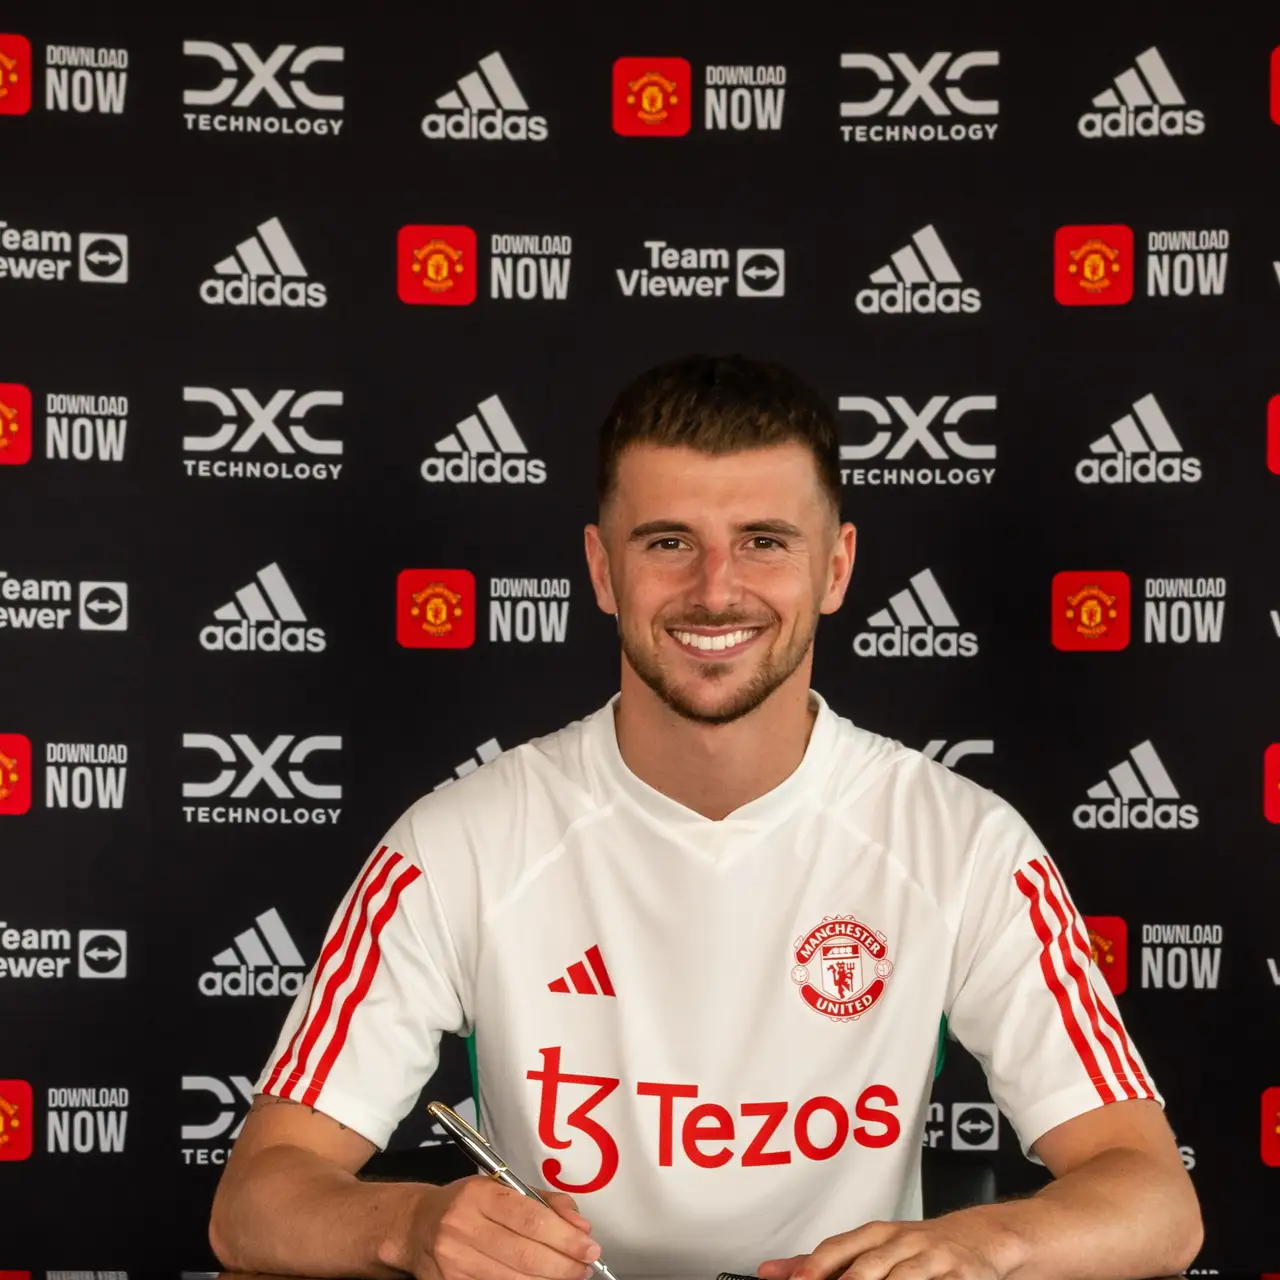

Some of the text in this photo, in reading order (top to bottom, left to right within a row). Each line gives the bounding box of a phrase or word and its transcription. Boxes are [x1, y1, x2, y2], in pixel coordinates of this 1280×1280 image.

[46, 44, 129, 69] DOWNLOAD
[45, 67, 127, 114] NOW
[183, 40, 344, 111] DXC
[705, 65, 786, 86] DOWNLOAD
[839, 50, 1000, 117] DXC
[183, 113, 343, 136] TECHNOLOGY
[421, 107, 549, 141] adidas
[705, 87, 785, 130] NOW
[1077, 103, 1205, 139] adidas
[840, 123, 998, 142] TECHNOLOGY
[491, 234, 572, 256] DOWNLOAD
[643, 240, 730, 270] Team
[1148, 229, 1229, 252] DOWNLOAD
[199, 273, 328, 308] adidas
[490, 256, 571, 300] NOW
[616, 268, 730, 297] Viewer
[1147, 252, 1228, 297] NOW
[855, 280, 982, 314] adidas
[46, 393, 129, 417] DOWNLOAD
[182, 386, 344, 455] DXC
[46, 416, 128, 462] NOW
[838, 395, 997, 460] DXC
[183, 459, 343, 480] TECHNOLOGY
[420, 450, 547, 484] adidas
[840, 468, 996, 485] TECHNOLOGY
[1075, 450, 1202, 484] adidas
[199, 618, 327, 653] adidas
[489, 600, 570, 643] NOW
[1144, 600, 1225, 644] NOW
[852, 624, 980, 658] adidas
[182, 733, 343, 800] DXC
[45, 765, 127, 809] NOW
[182, 806, 342, 825] TECHNOLOGY
[1072, 796, 1200, 830] adidas
[799, 922, 882, 959] MANCHESTER
[1142, 924, 1223, 945] DOWNLOAD
[1141, 947, 1222, 989] NOW
[815, 993, 874, 1016] UNITED
[47, 1087, 129, 1108] DOWNLOAD
[47, 1110, 128, 1153] NOW
[636, 1081, 902, 1169] Tezos
